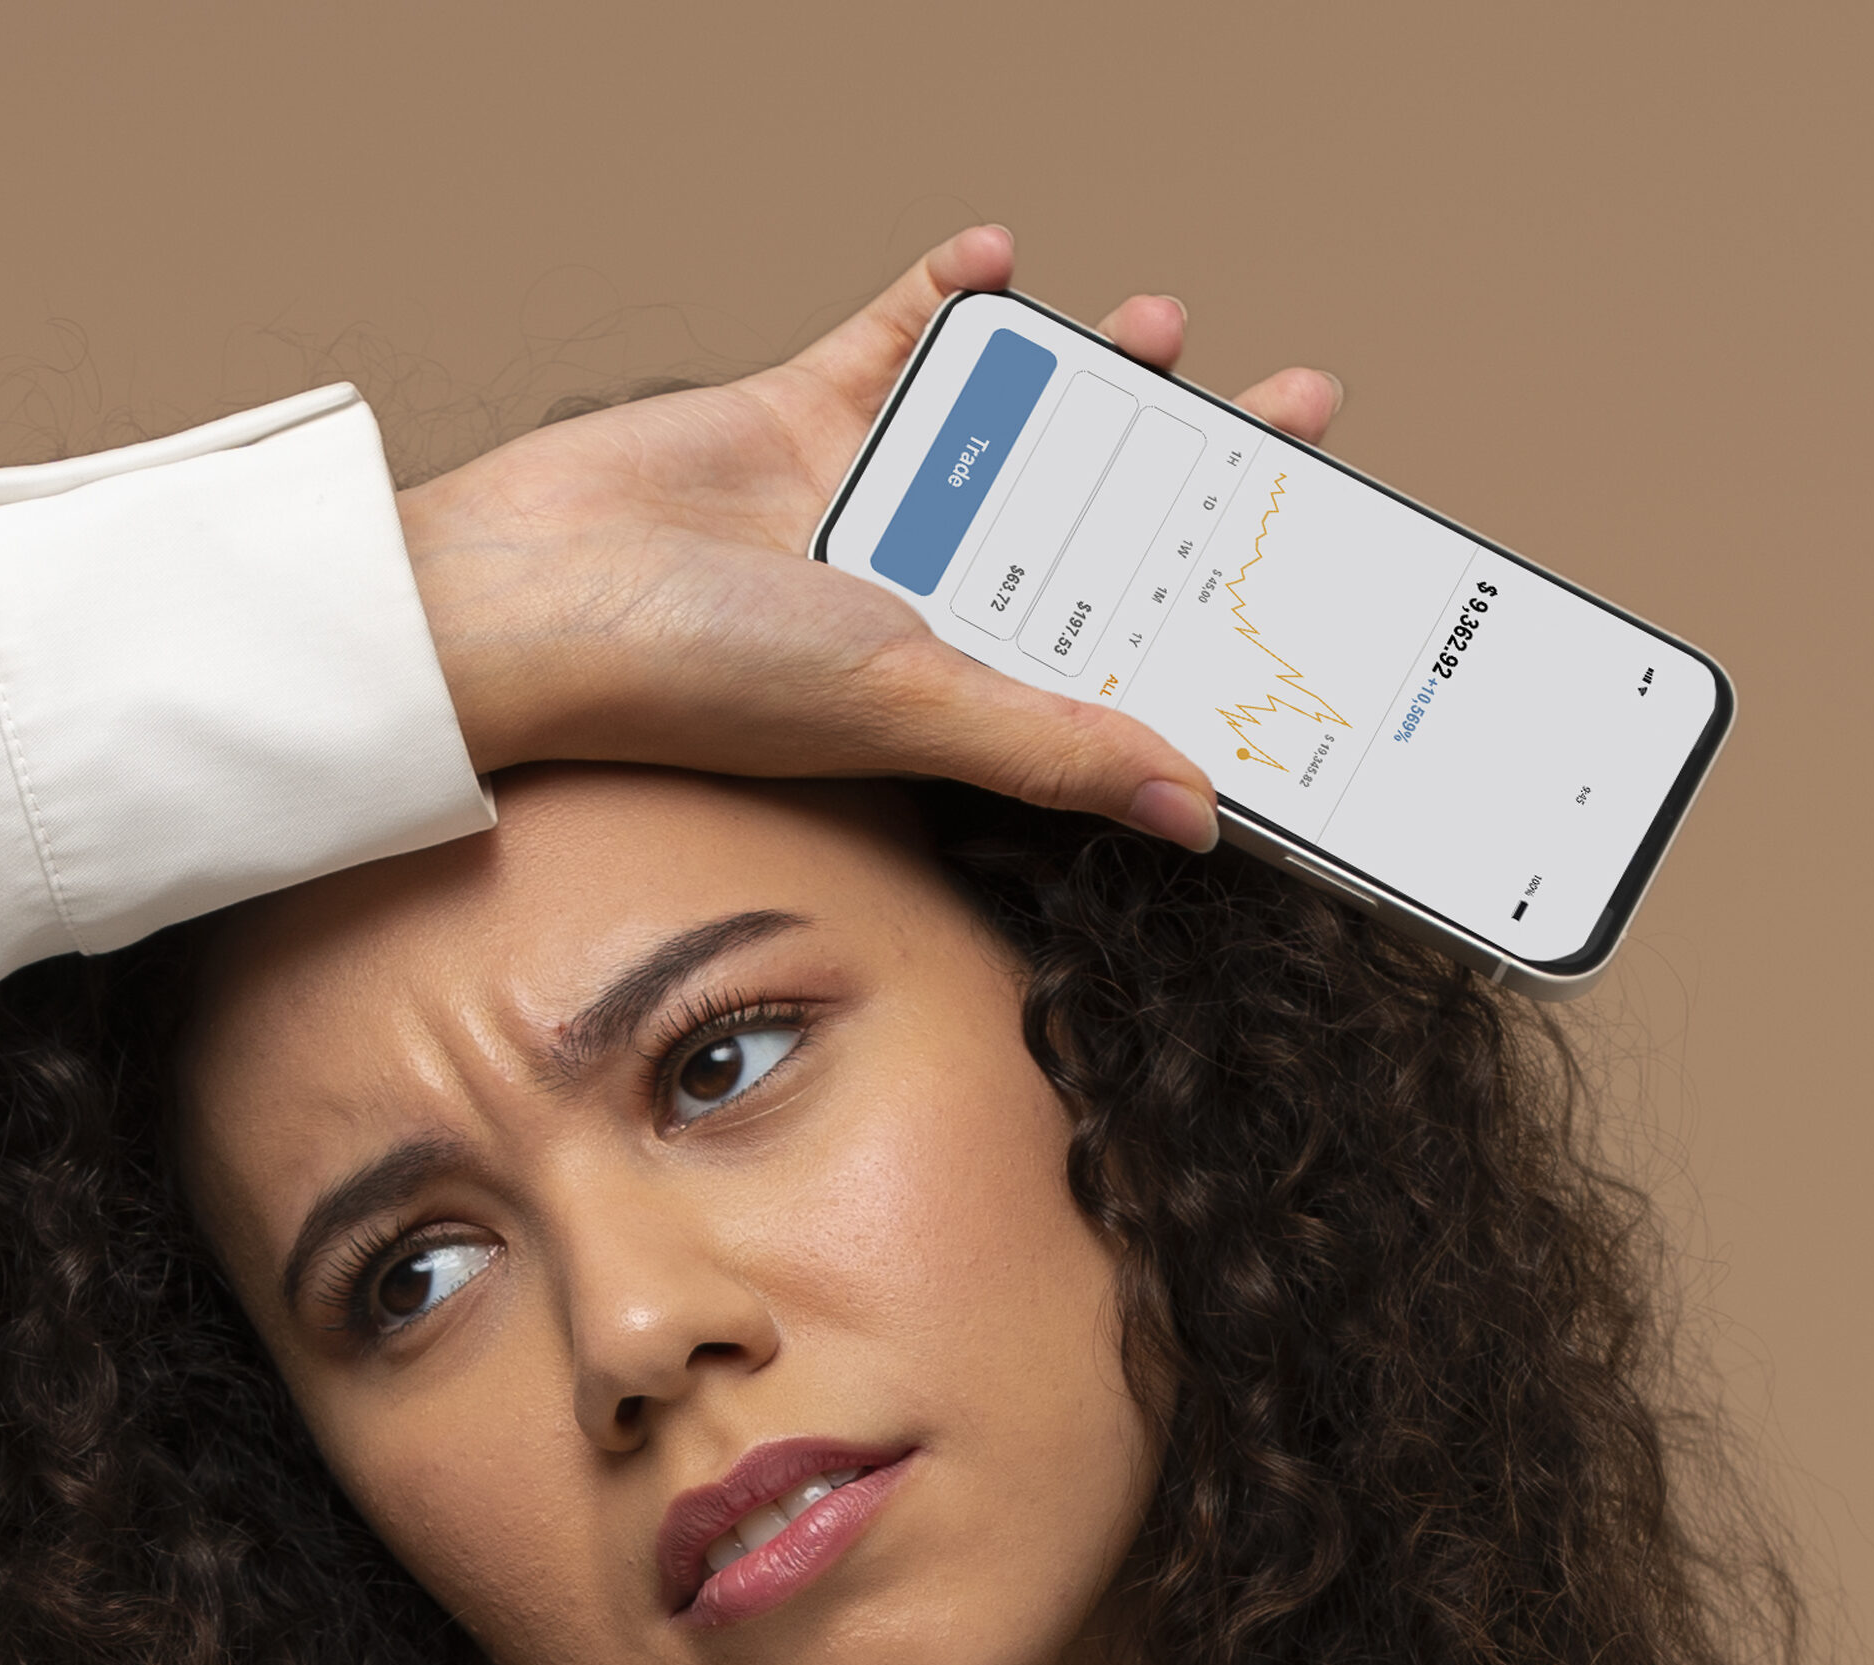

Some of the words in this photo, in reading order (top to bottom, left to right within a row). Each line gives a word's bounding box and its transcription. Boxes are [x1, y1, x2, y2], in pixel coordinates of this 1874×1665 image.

[947, 436, 990, 488] Trade
[1226, 450, 1242, 467] 1H
[1202, 495, 1218, 511] 1D
[1177, 540, 1194, 559] 1W
[1212, 568, 1223, 578] $
[990, 564, 1025, 612] $63.72
[1151, 586, 1168, 604] 1M
[1198, 576, 1218, 604] 45,00
[1476, 581, 1498, 598] $
[1053, 600, 1092, 657] $197.53
[1431, 597, 1489, 680] 9,362.92
[1128, 632, 1143, 649] 1Y
[1099, 673, 1119, 697] ALL
[1393, 677, 1438, 743] +10,569%
[1324, 733, 1335, 743] $
[1299, 743, 1330, 788] 19,345.82
[1575, 786, 1592, 806] 9:45
[1524, 874, 1543, 897] 100%
